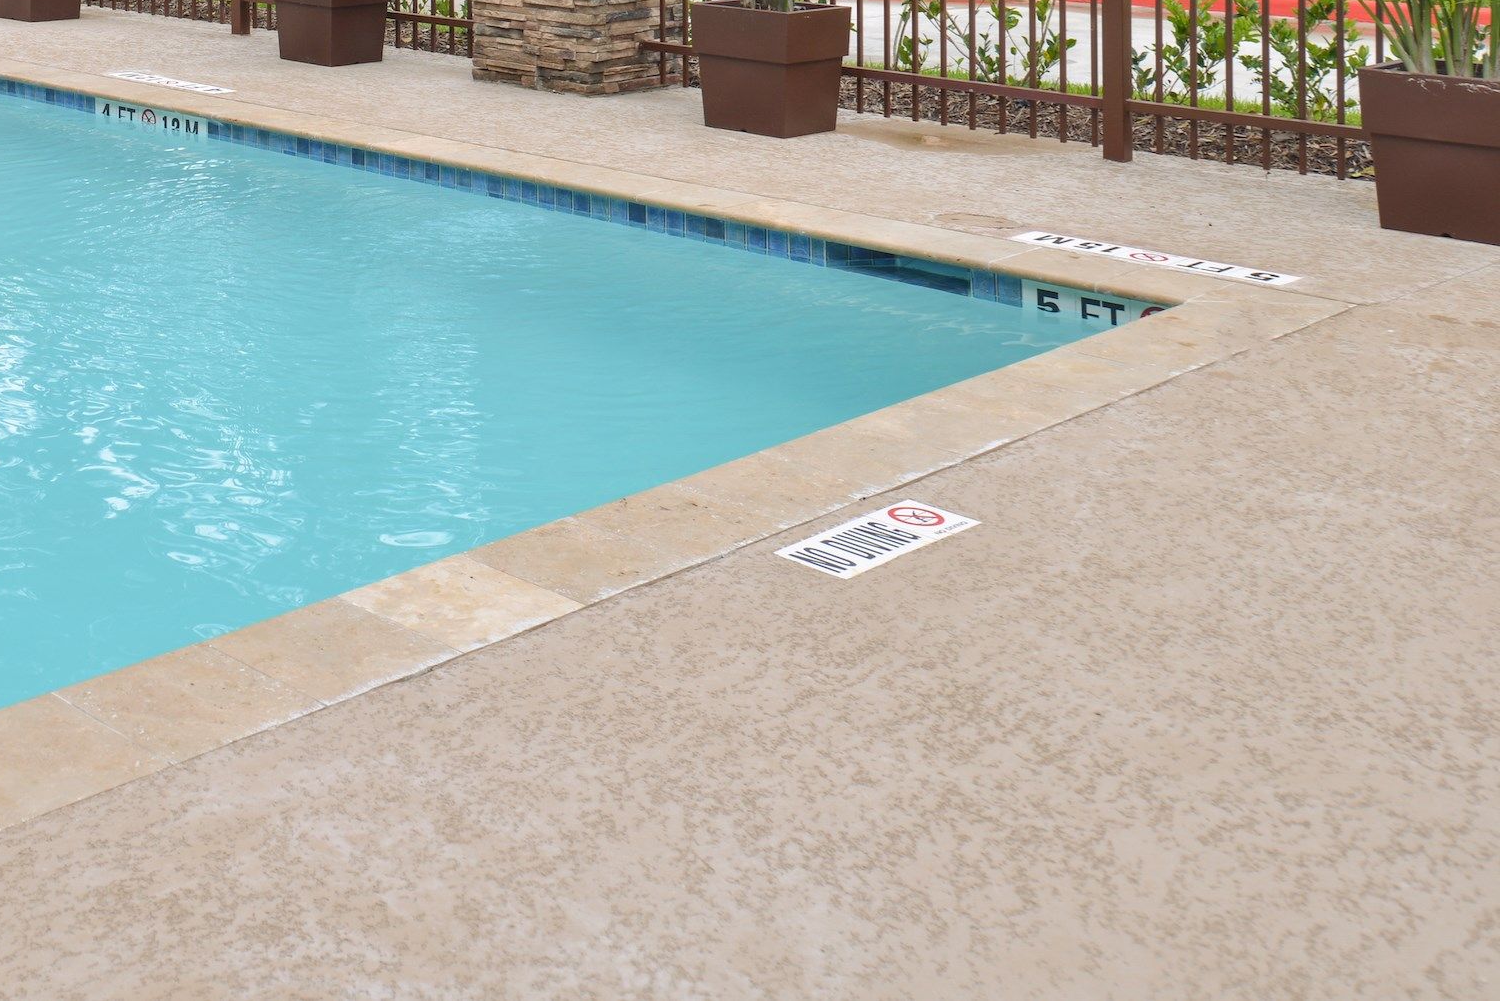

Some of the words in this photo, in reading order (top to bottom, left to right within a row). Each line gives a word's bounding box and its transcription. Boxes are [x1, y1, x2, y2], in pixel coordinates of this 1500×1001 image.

[118, 105, 136, 121] FT
[1177, 260, 1236, 274] FT
[1245, 271, 1280, 283] 5
[1037, 288, 1060, 313] 5
[1080, 296, 1126, 326] FT
[820, 521, 922, 560] DIVING
[789, 547, 857, 574] NO
